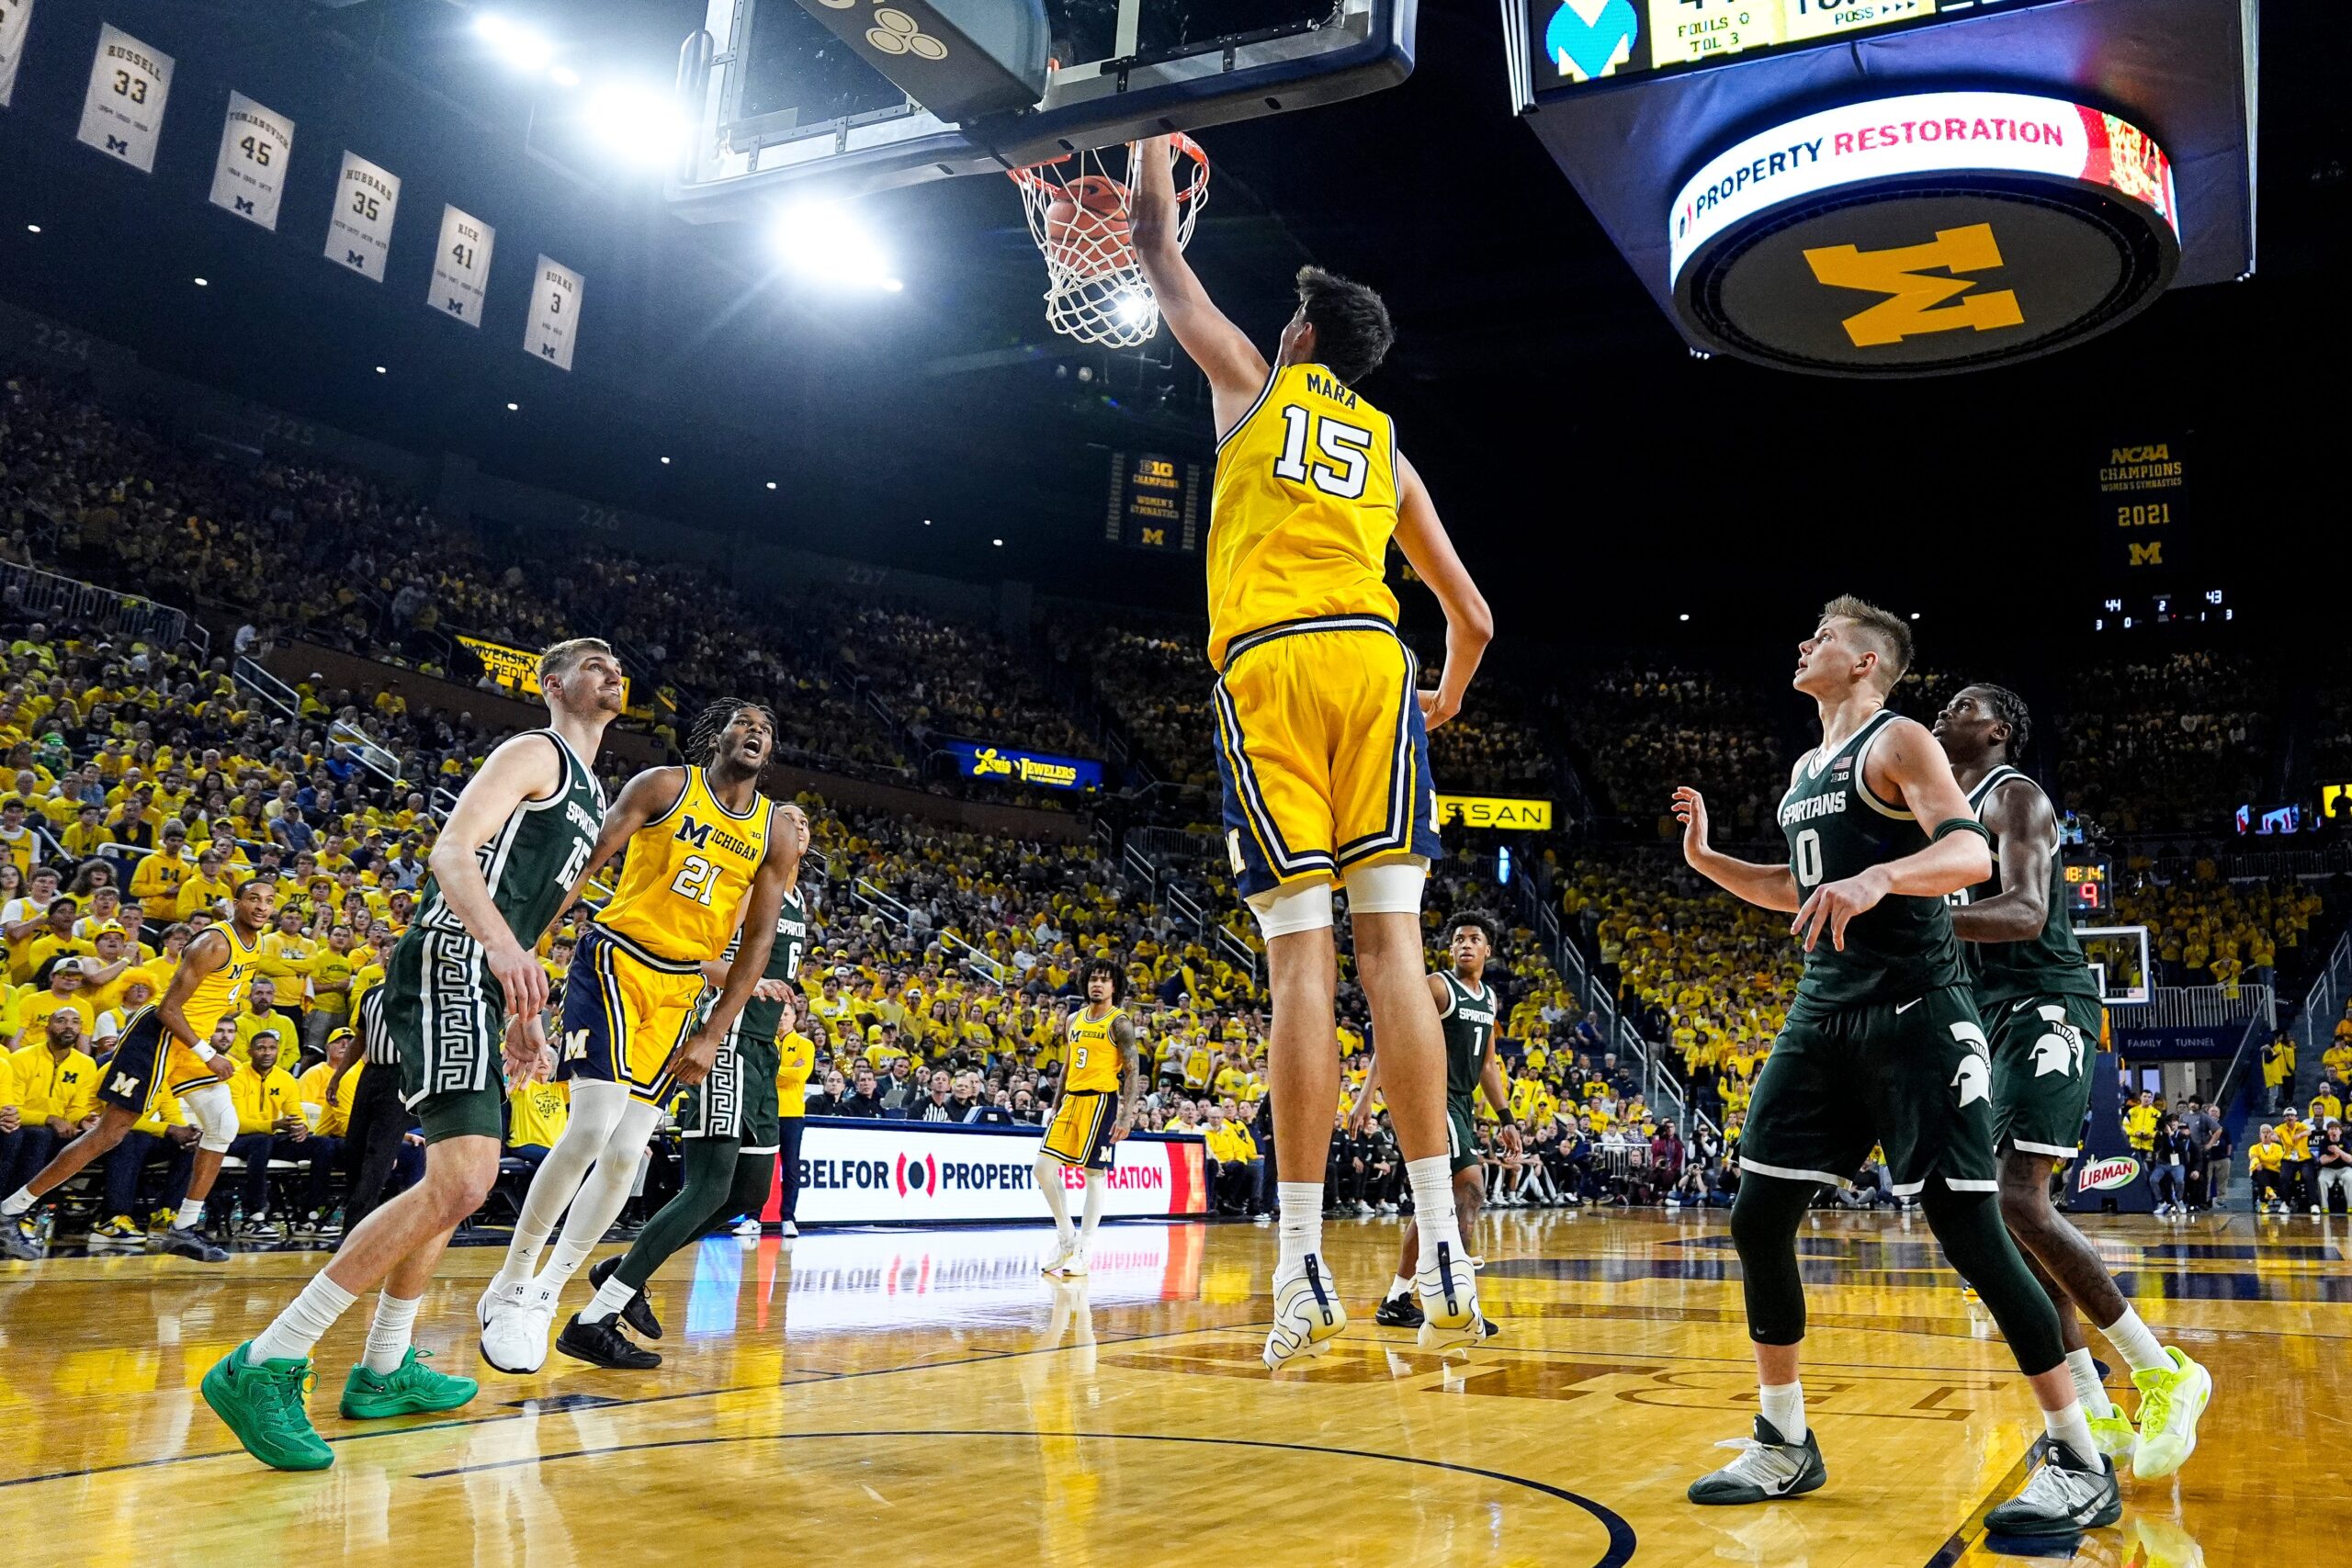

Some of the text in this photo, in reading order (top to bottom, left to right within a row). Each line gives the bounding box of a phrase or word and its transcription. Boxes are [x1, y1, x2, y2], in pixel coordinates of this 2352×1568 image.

[1679, 17, 1729, 38] FOULS
[1835, 6, 1874, 25] POSS
[1690, 32, 1740, 53] TOL 3
[107, 45, 162, 82] RUSSELL
[113, 69, 148, 105] 33
[106, 133, 129, 156] M
[241, 136, 273, 167] 45
[1696, 117, 2064, 219] PROPERTY RESTORATION
[345, 169, 392, 201] HUBBARD
[234, 195, 254, 216] M
[352, 191, 380, 221] 35
[458, 223, 480, 243] RICE
[346, 249, 364, 269] M
[452, 243, 473, 270] 41
[546, 271, 572, 292] BURKE
[1802, 221, 2025, 347] M
[447, 298, 464, 316] M
[550, 292, 561, 314] 3
[542, 343, 555, 359] M
[1306, 373, 1357, 411] MARA
[1272, 403, 1373, 500] 15
[2110, 444, 2169, 465] NCAA
[2099, 462, 2182, 481] CHAMPIONS
[2118, 503, 2169, 526] 2021
[1142, 527, 1164, 545] M
[2128, 541, 2163, 566] M
[2105, 599, 2121, 612] 44
[2206, 590, 2222, 604] 43
[1782, 790, 1847, 827] SPARTANS
[674, 815, 758, 863] MICHIGAN
[554, 837, 593, 892] 15
[1796, 829, 1823, 887] 0
[670, 854, 725, 907] 21
[2065, 866, 2100, 881] 18:14
[2080, 883, 2098, 908] 9
[787, 942, 802, 979] 6
[228, 982, 243, 1005] 4
[564, 1029, 590, 1062] M
[1474, 1026, 1484, 1055] 1
[2128, 1038, 2215, 1048] FAMILY TUNNEL
[1076, 1047, 1089, 1069] 3
[62, 1071, 78, 1084] M
[109, 1072, 140, 1098] M
[1099, 1146, 1113, 1162] M
[798, 1160, 888, 1190] BELFOR
[943, 1163, 1034, 1190] PROPERT
[2081, 1162, 2132, 1189] LIBMAN
